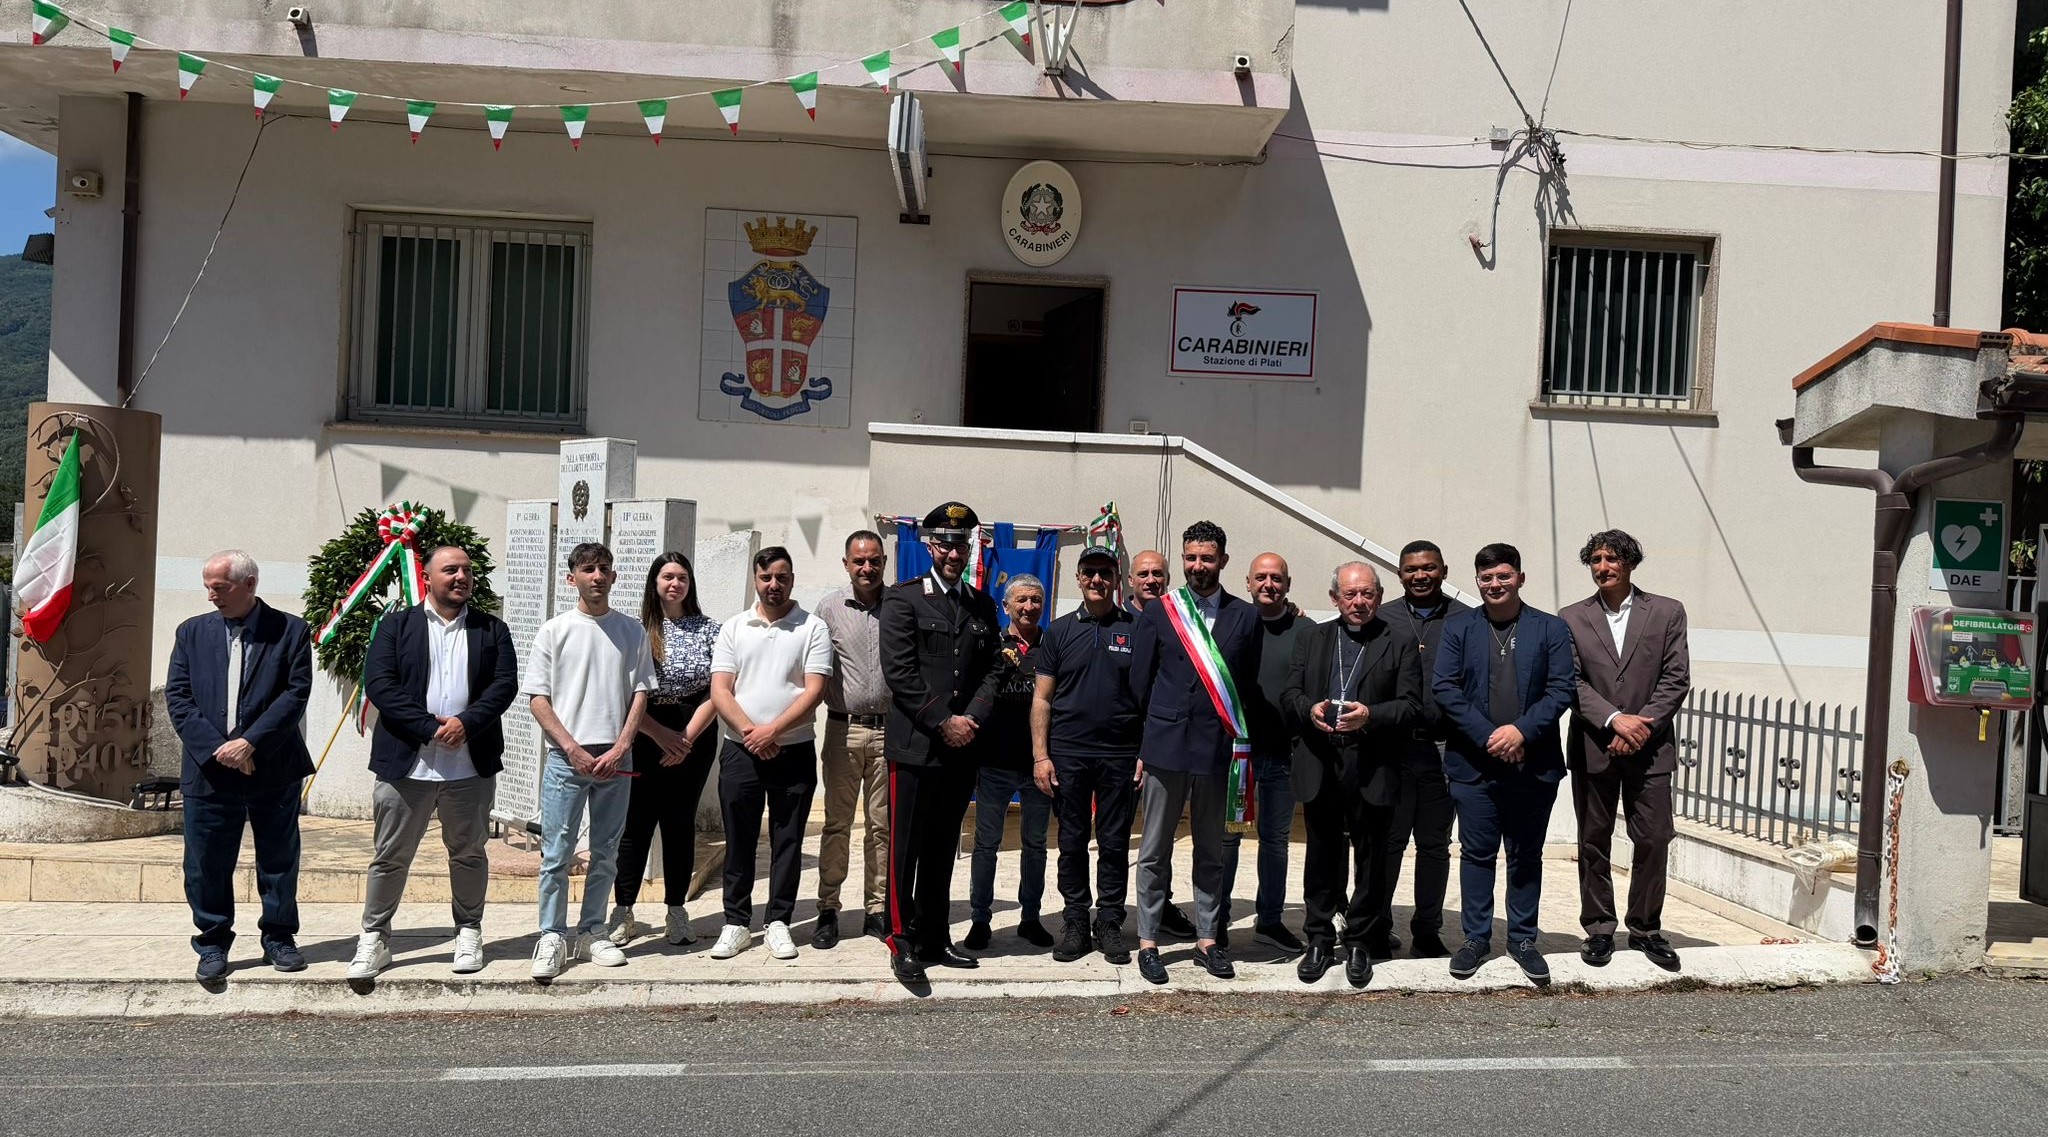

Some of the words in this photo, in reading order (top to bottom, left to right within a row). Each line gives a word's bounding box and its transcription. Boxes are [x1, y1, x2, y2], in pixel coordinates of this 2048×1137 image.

[1008, 228, 1072, 252] CARABINIERI
[1178, 336, 1308, 357] CARABINIERI
[1204, 356, 1246, 366] Stazione
[1248, 357, 1258, 366] di
[1950, 574, 1981, 586] DAE
[1952, 620, 2025, 631] DEFIBRILLATORE
[1982, 648, 1996, 656] AED
